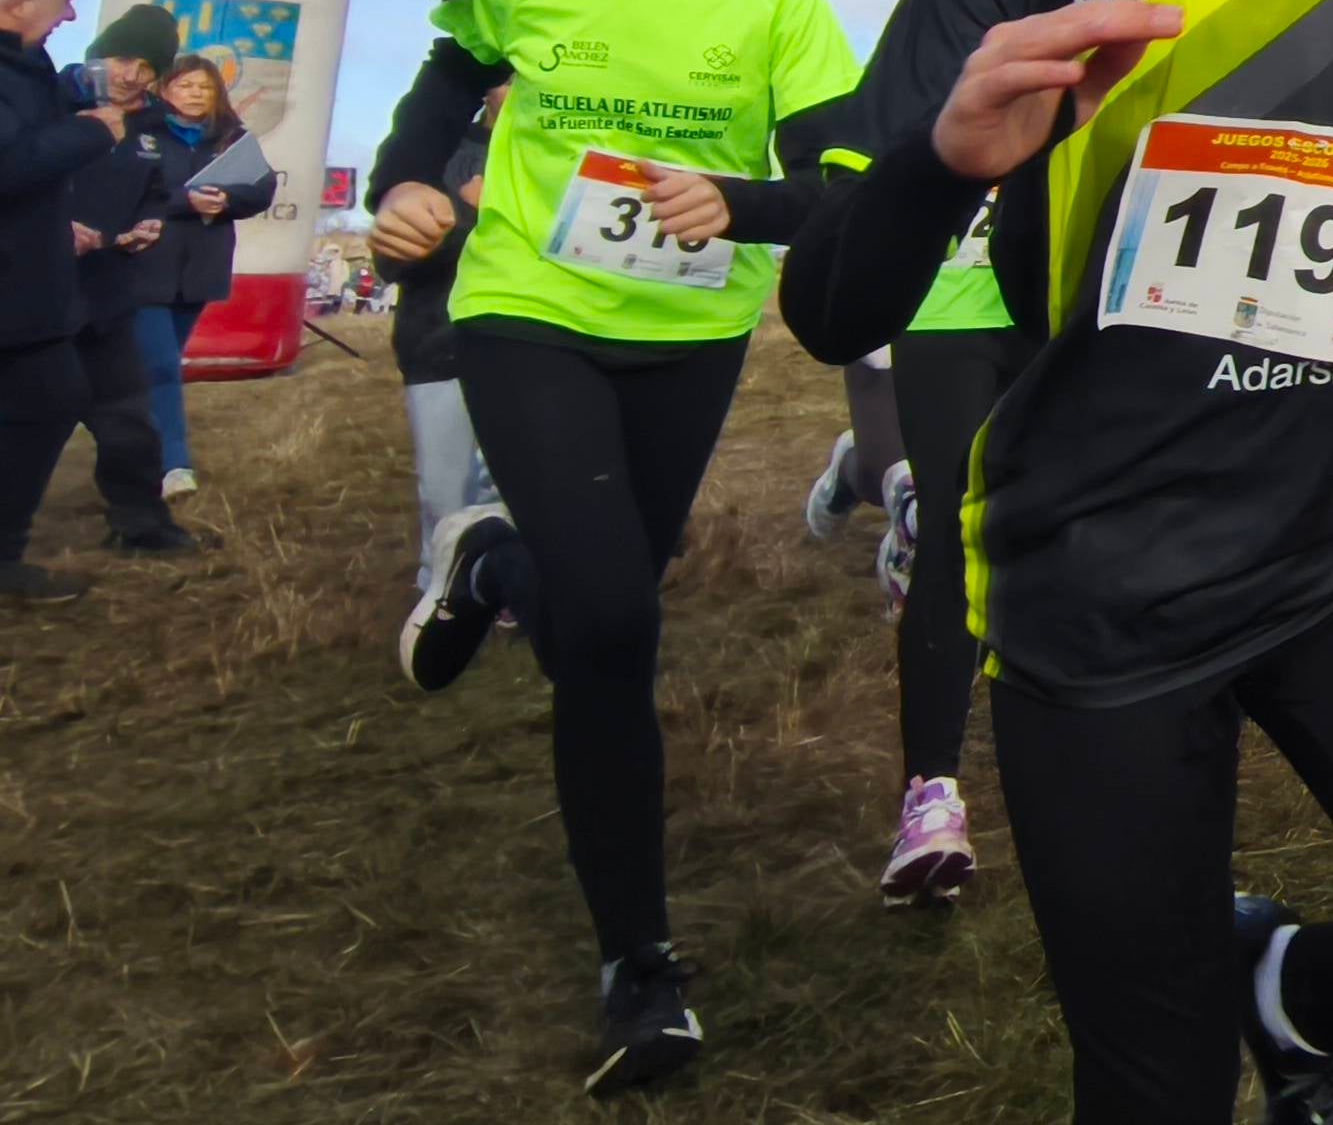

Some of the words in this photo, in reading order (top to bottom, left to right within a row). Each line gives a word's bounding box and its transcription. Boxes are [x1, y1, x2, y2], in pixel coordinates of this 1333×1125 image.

[539, 92, 609, 113] ESCUELA
[613, 98, 636, 115] DE
[638, 101, 733, 122] ATLETISMO
[559, 115, 614, 131] Fuente
[616, 118, 634, 133] de
[635, 123, 662, 139] San
[1211, 132, 1285, 148] JUEGOS
